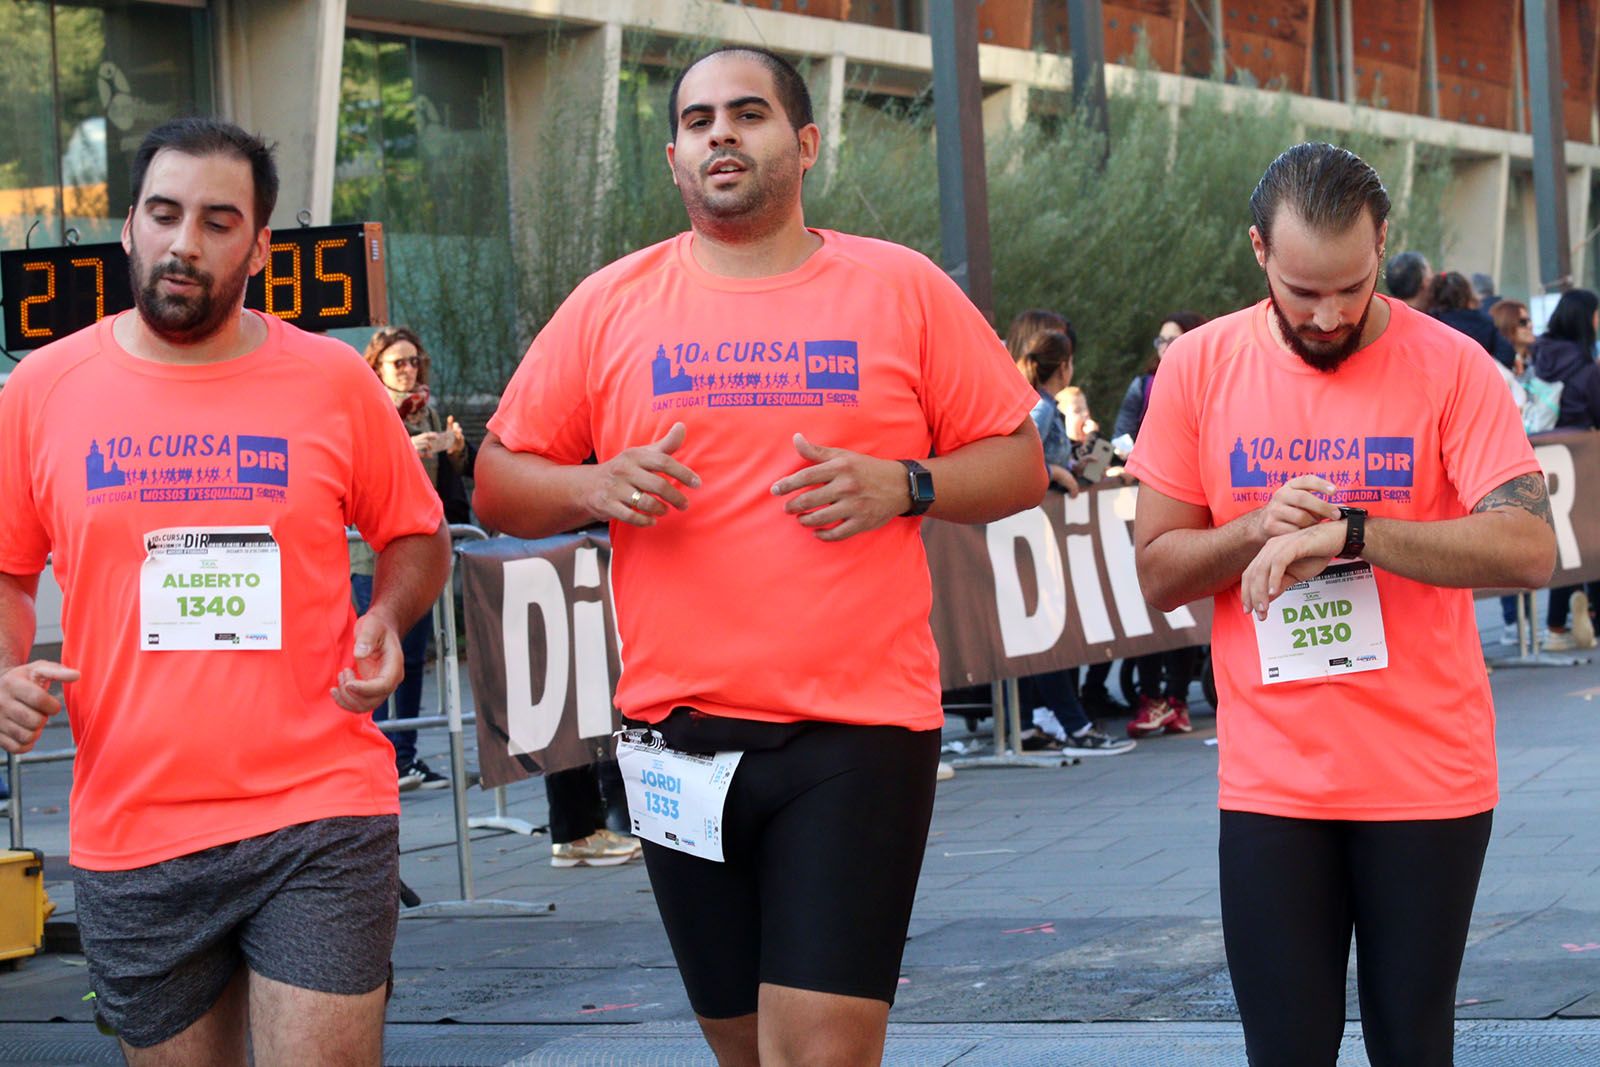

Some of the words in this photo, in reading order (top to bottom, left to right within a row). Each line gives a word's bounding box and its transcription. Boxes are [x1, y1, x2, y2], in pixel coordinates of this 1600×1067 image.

[20, 257, 104, 338] 27
[264, 238, 352, 320] 85
[716, 341, 799, 362] CURSA
[808, 355, 856, 375] DiR
[652, 400, 673, 413] SANT
[676, 396, 705, 408] CUGAT
[711, 393, 754, 406] MOSSOS
[756, 392, 821, 406] D'ESQUADRA
[148, 434, 231, 458] CURSA
[1288, 437, 1360, 461] CURSA
[239, 449, 287, 471] DiR
[1367, 453, 1411, 472] DiR
[86, 493, 106, 507] SANT
[108, 490, 137, 504] CUGAT
[144, 488, 187, 501] MOSSOS
[188, 487, 250, 501] D'ESQUADRA
[1233, 492, 1251, 502] SANT
[1254, 492, 1273, 502] CUGA
[162, 534, 184, 542] CURSA
[185, 533, 209, 548] DiR
[162, 573, 261, 588] ALBERTO
[177, 595, 246, 617] 1340
[1282, 599, 1353, 624] DAVID
[1292, 622, 1352, 648] 2130
[640, 769, 682, 794] JORDI
[644, 791, 680, 820] 1333
